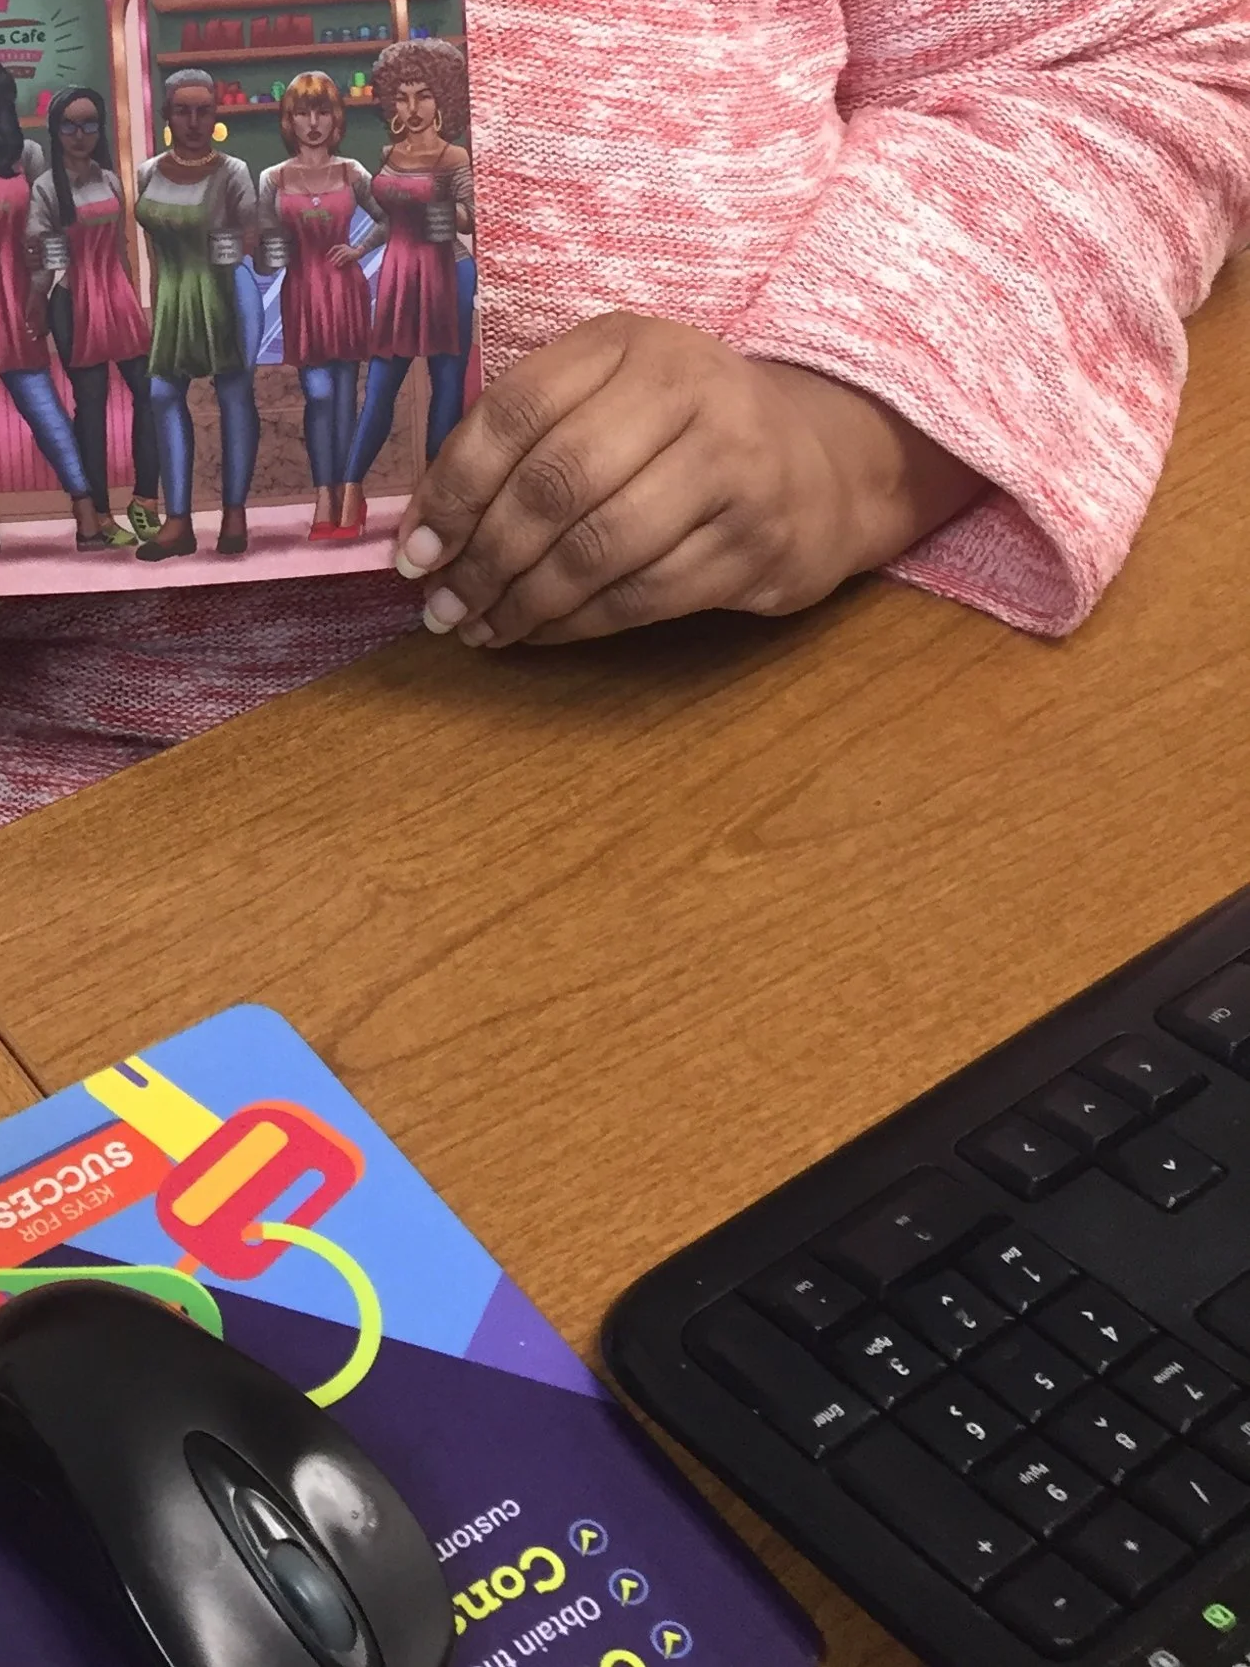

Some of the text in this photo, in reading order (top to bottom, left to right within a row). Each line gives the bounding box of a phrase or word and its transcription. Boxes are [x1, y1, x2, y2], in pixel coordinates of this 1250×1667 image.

[10, 29, 46, 44] Cafe
[17, 1184, 114, 1243] KEYS FOR
[890, 1357, 910, 1376] 3
[1034, 1372, 1055, 1390] 5
[813, 1403, 845, 1427] Enter
[965, 1422, 986, 1440] 6
[1115, 1432, 1137, 1450] 8
[1047, 1484, 1068, 1502] 9
[513, 1595, 601, 1653] Obtain
